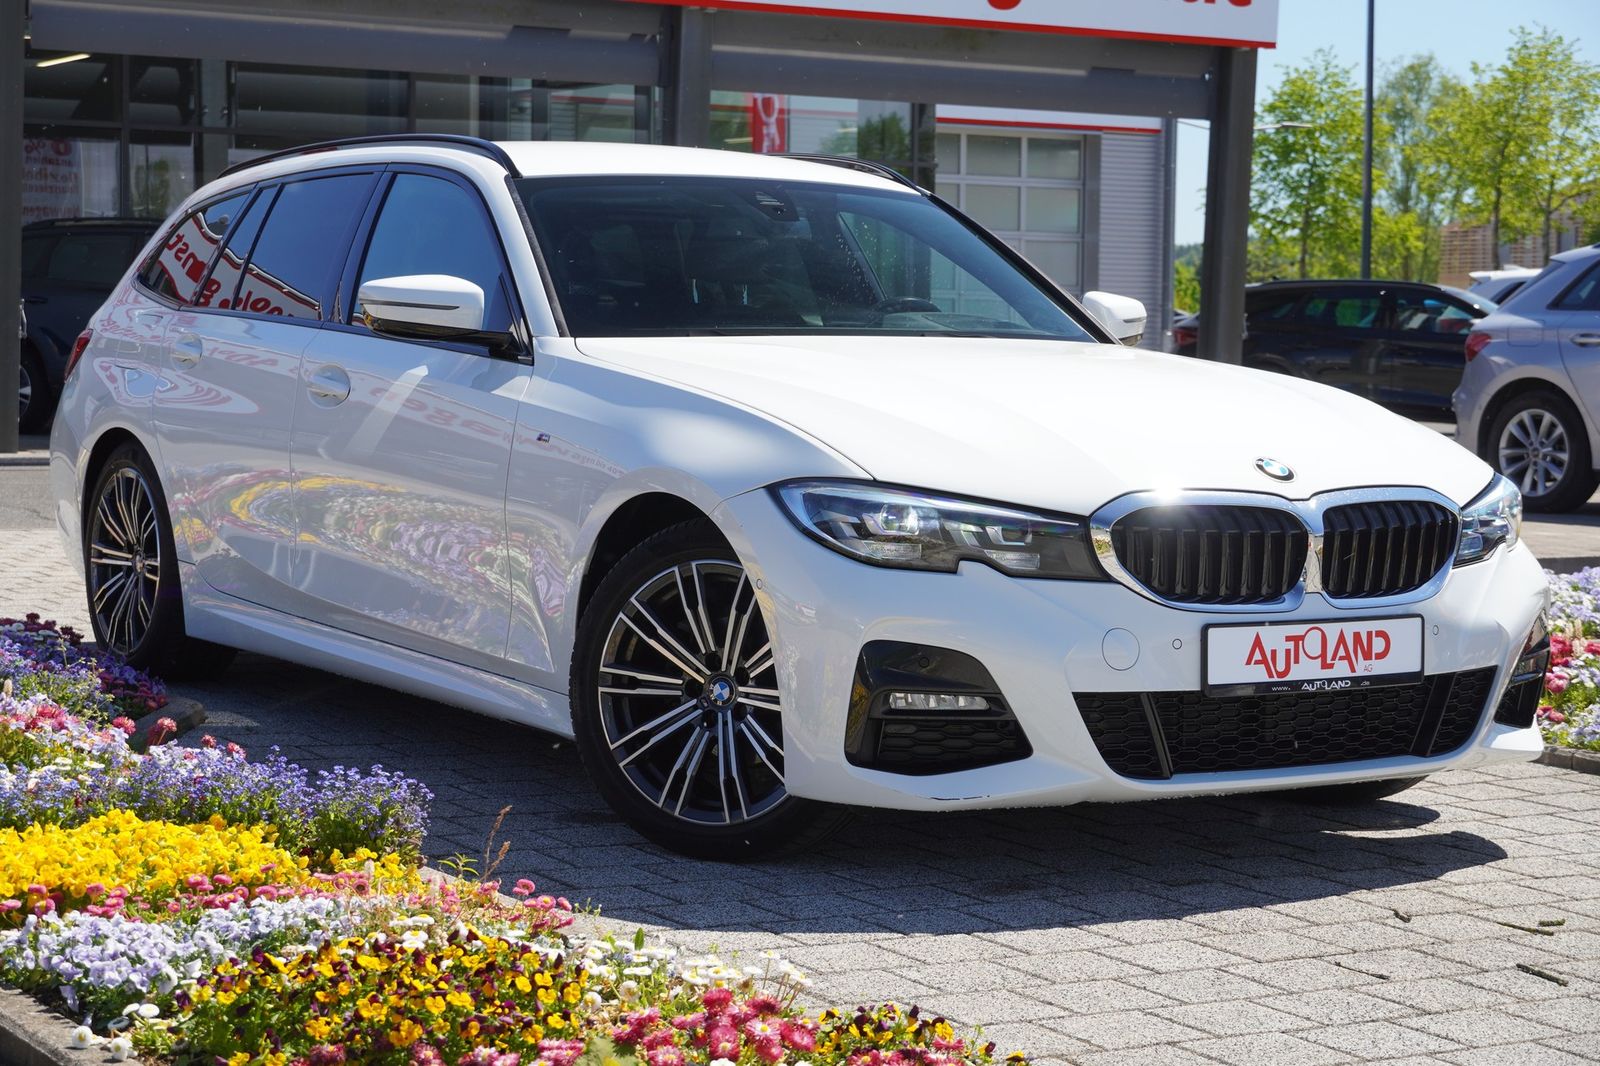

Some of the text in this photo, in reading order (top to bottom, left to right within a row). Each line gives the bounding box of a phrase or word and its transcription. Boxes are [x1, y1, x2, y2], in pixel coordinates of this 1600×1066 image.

[1245, 626, 1391, 679] AUTOLAND
[1363, 663, 1374, 673] AG
[1301, 679, 1351, 691] AUTOLAND
